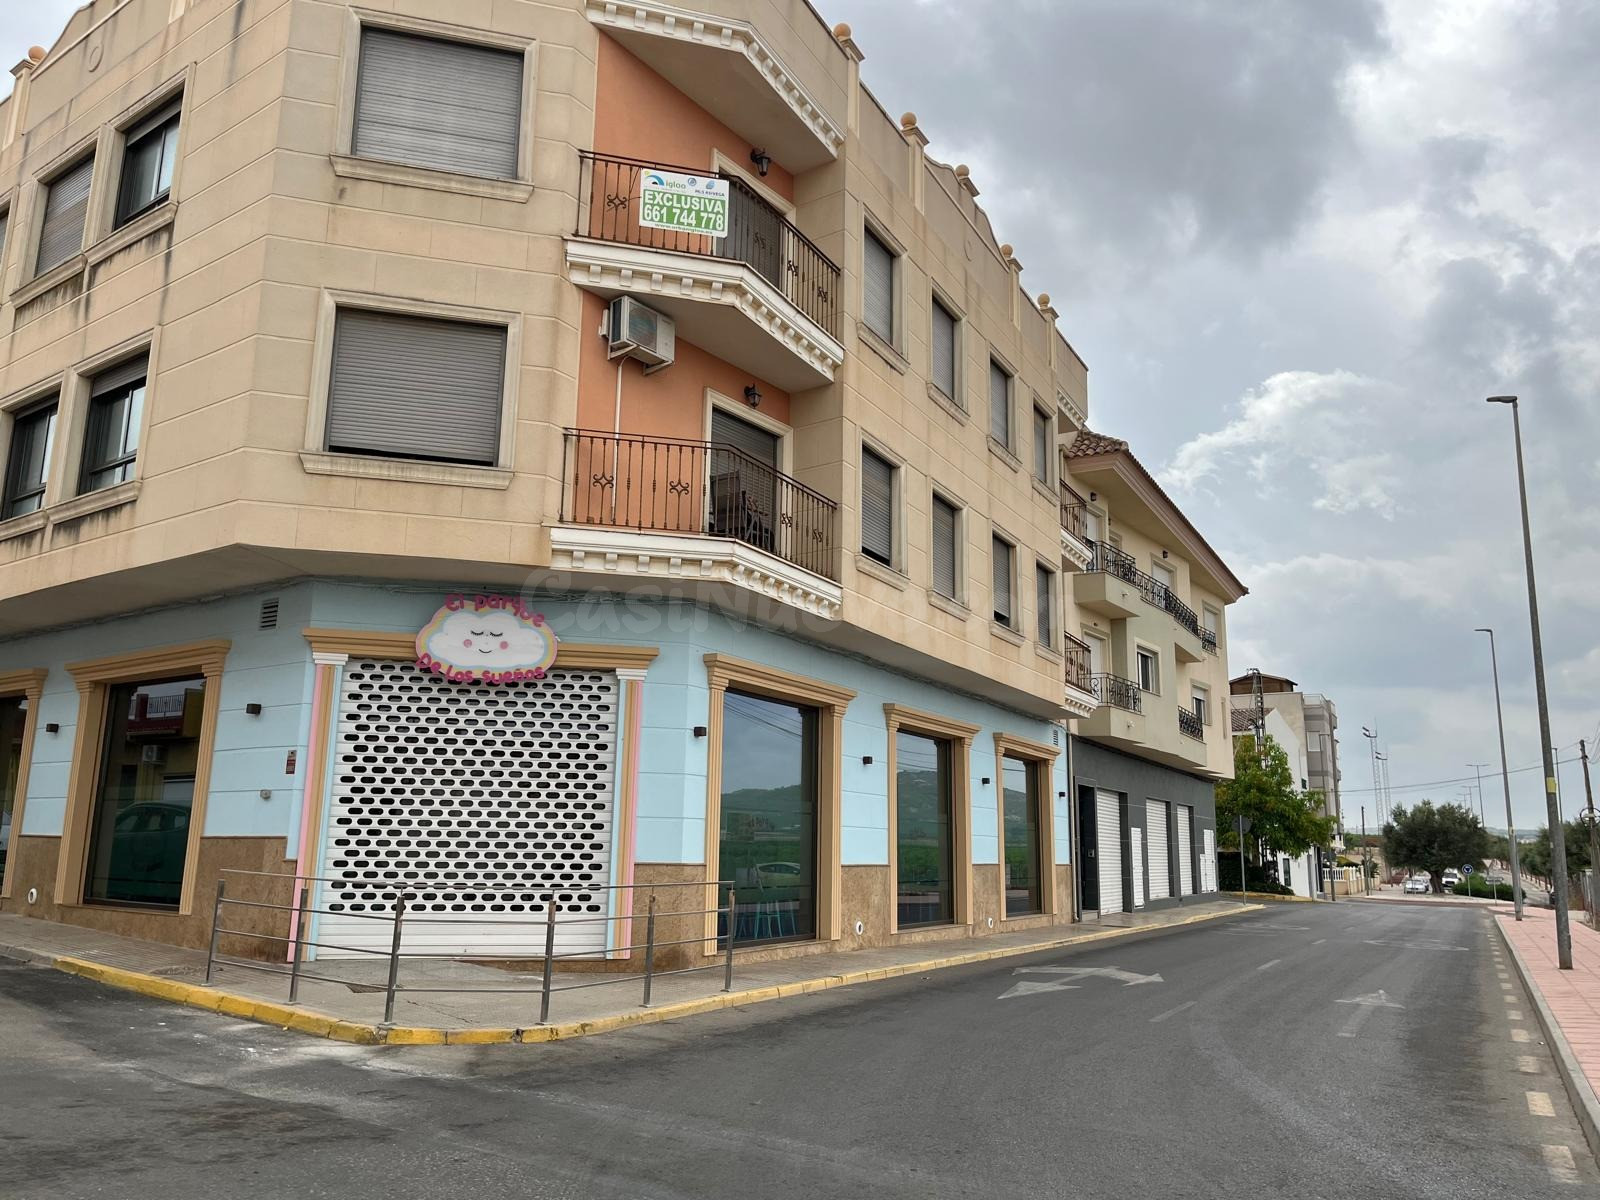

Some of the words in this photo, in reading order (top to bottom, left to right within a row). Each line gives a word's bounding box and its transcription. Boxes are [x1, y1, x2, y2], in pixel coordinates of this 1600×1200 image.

[644, 190, 724, 214] EXCLUSIVA
[644, 204, 667, 223] 661
[672, 208, 697, 227] 744
[700, 212, 724, 231] 778
[445, 593, 465, 611] El
[474, 594, 545, 627] parque
